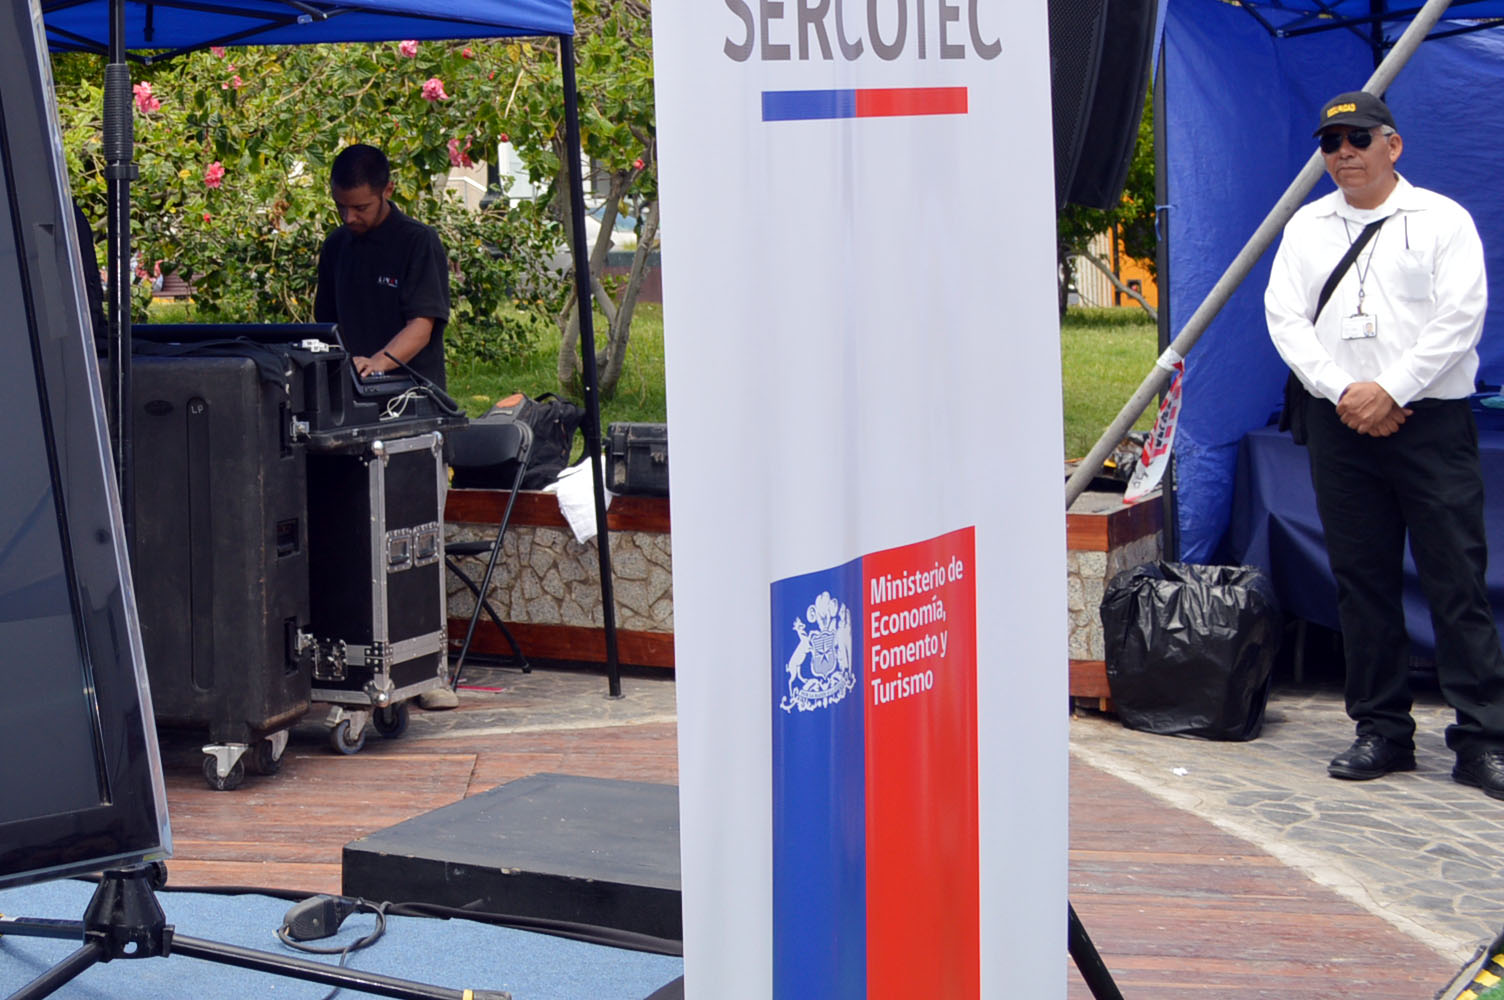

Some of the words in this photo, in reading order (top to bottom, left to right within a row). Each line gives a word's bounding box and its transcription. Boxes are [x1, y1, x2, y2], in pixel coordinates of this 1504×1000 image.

[871, 561, 946, 605] Ministerio
[948, 555, 963, 582] de
[871, 595, 946, 638] Economía,
[871, 634, 938, 672] Fomento
[940, 630, 948, 658] y
[871, 670, 934, 706] Turismo
